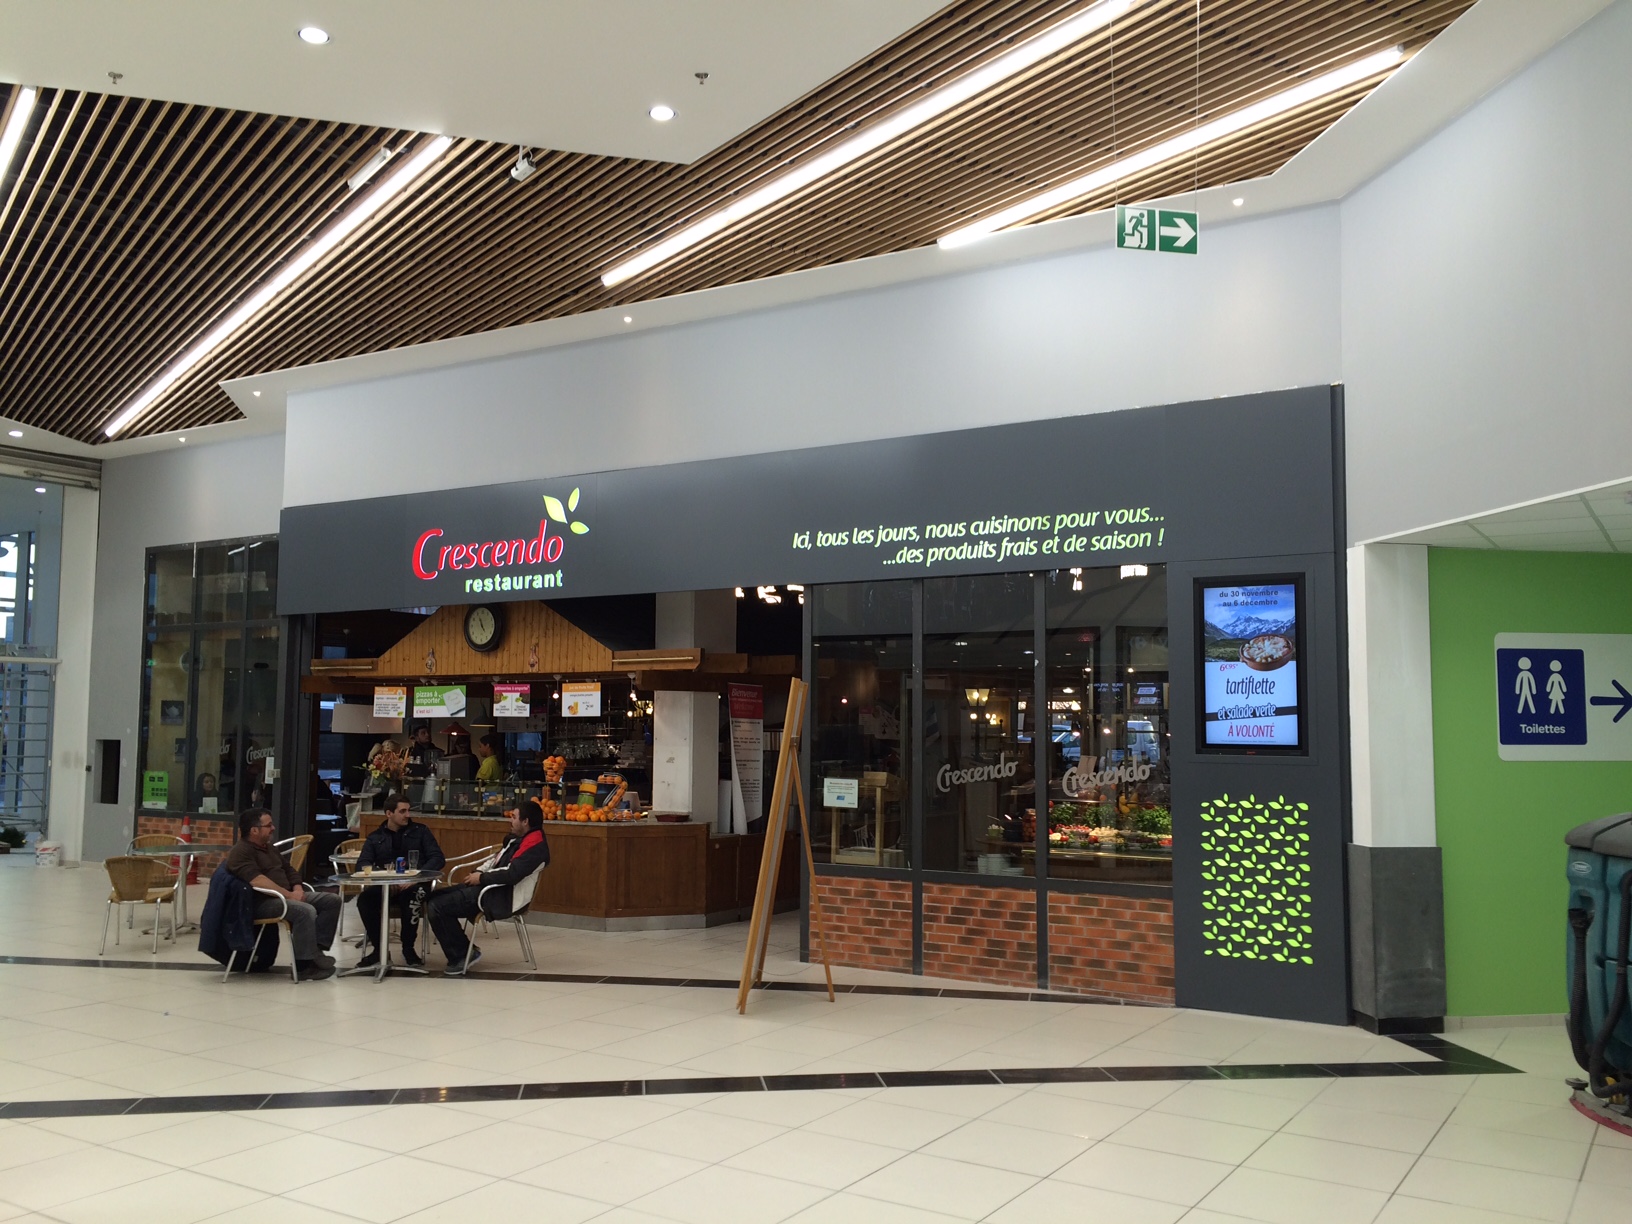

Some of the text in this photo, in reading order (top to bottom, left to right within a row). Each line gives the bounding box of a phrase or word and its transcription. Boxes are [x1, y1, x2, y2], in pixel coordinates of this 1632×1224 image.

[792, 506, 1165, 550] Ici, tous les jours, nous cuisinons pour vous...
[412, 518, 564, 580] Crescendo
[882, 527, 1165, 567] ...des produits frais et de saison !
[465, 569, 563, 593] restaurant
[1241, 589, 1279, 597] novembre
[1226, 675, 1276, 700] tartiflette
[1217, 702, 1277, 720] et salade verte
[1227, 722, 1275, 738] À VOLONTÉ
[1520, 723, 1566, 734] Toilettes
[936, 752, 1019, 793] Crescendo
[1062, 754, 1154, 798] Crescendo
